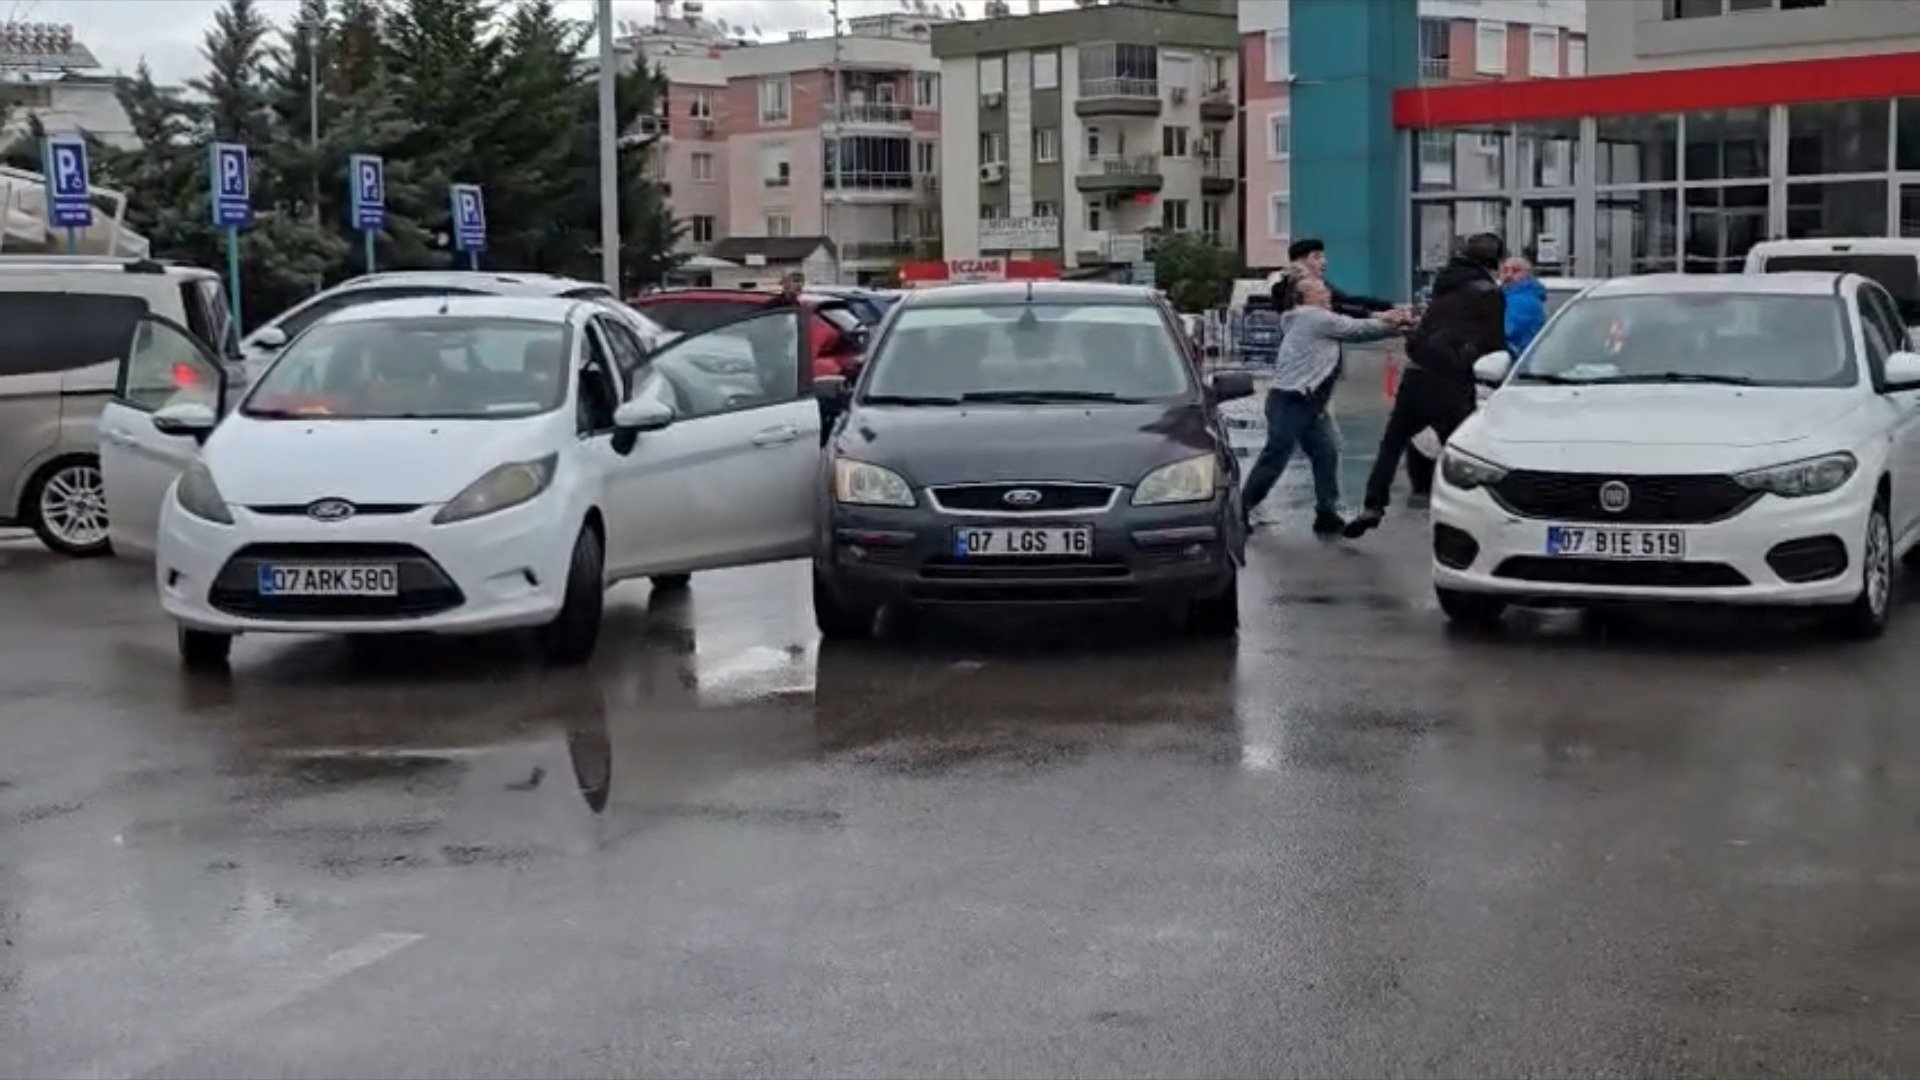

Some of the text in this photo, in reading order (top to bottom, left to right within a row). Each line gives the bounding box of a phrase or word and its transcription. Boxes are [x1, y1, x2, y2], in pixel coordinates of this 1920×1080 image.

[56, 148, 76, 190] P
[222, 153, 239, 191] P
[362, 164, 376, 199] P
[461, 193, 476, 223] P
[967, 531, 1086, 552] 07 LGS 16
[1561, 530, 1680, 555] 07 BIE 519
[273, 569, 394, 591] 07 ARK 580
